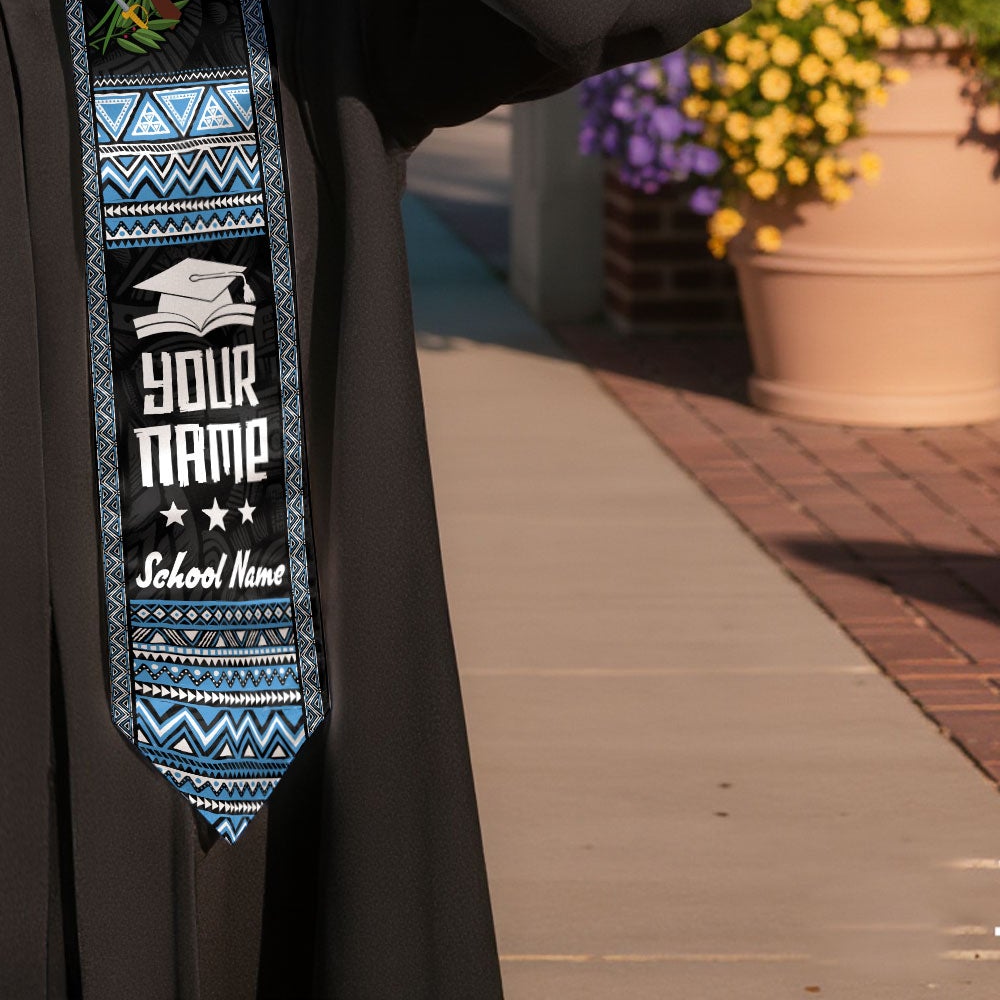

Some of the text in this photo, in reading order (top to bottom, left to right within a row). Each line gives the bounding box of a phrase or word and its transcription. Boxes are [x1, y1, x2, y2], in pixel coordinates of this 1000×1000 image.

[141, 343, 260, 415] YOUR
[133, 417, 269, 488] NAME
[135, 549, 286, 590] School Name
